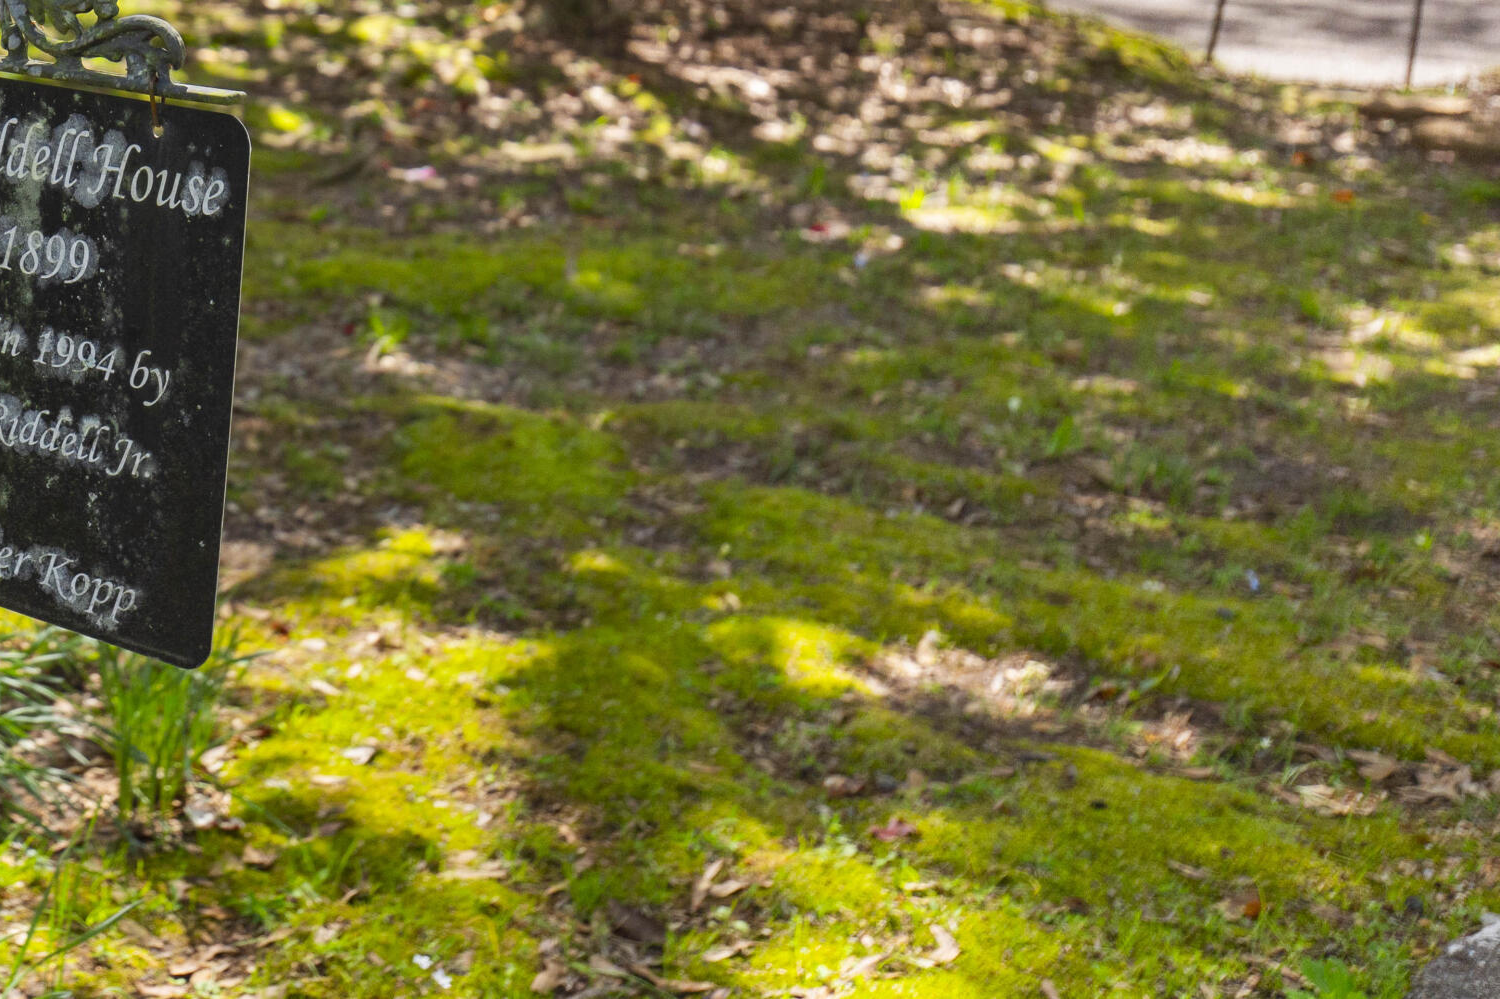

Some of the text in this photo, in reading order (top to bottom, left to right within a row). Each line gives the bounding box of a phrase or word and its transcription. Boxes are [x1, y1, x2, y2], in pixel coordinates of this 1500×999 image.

[87, 143, 226, 216] House
[33, 330, 117, 382] 1994
[129, 350, 171, 406] by
[105, 438, 152, 478] Jr.
[39, 552, 137, 624] Kopp
